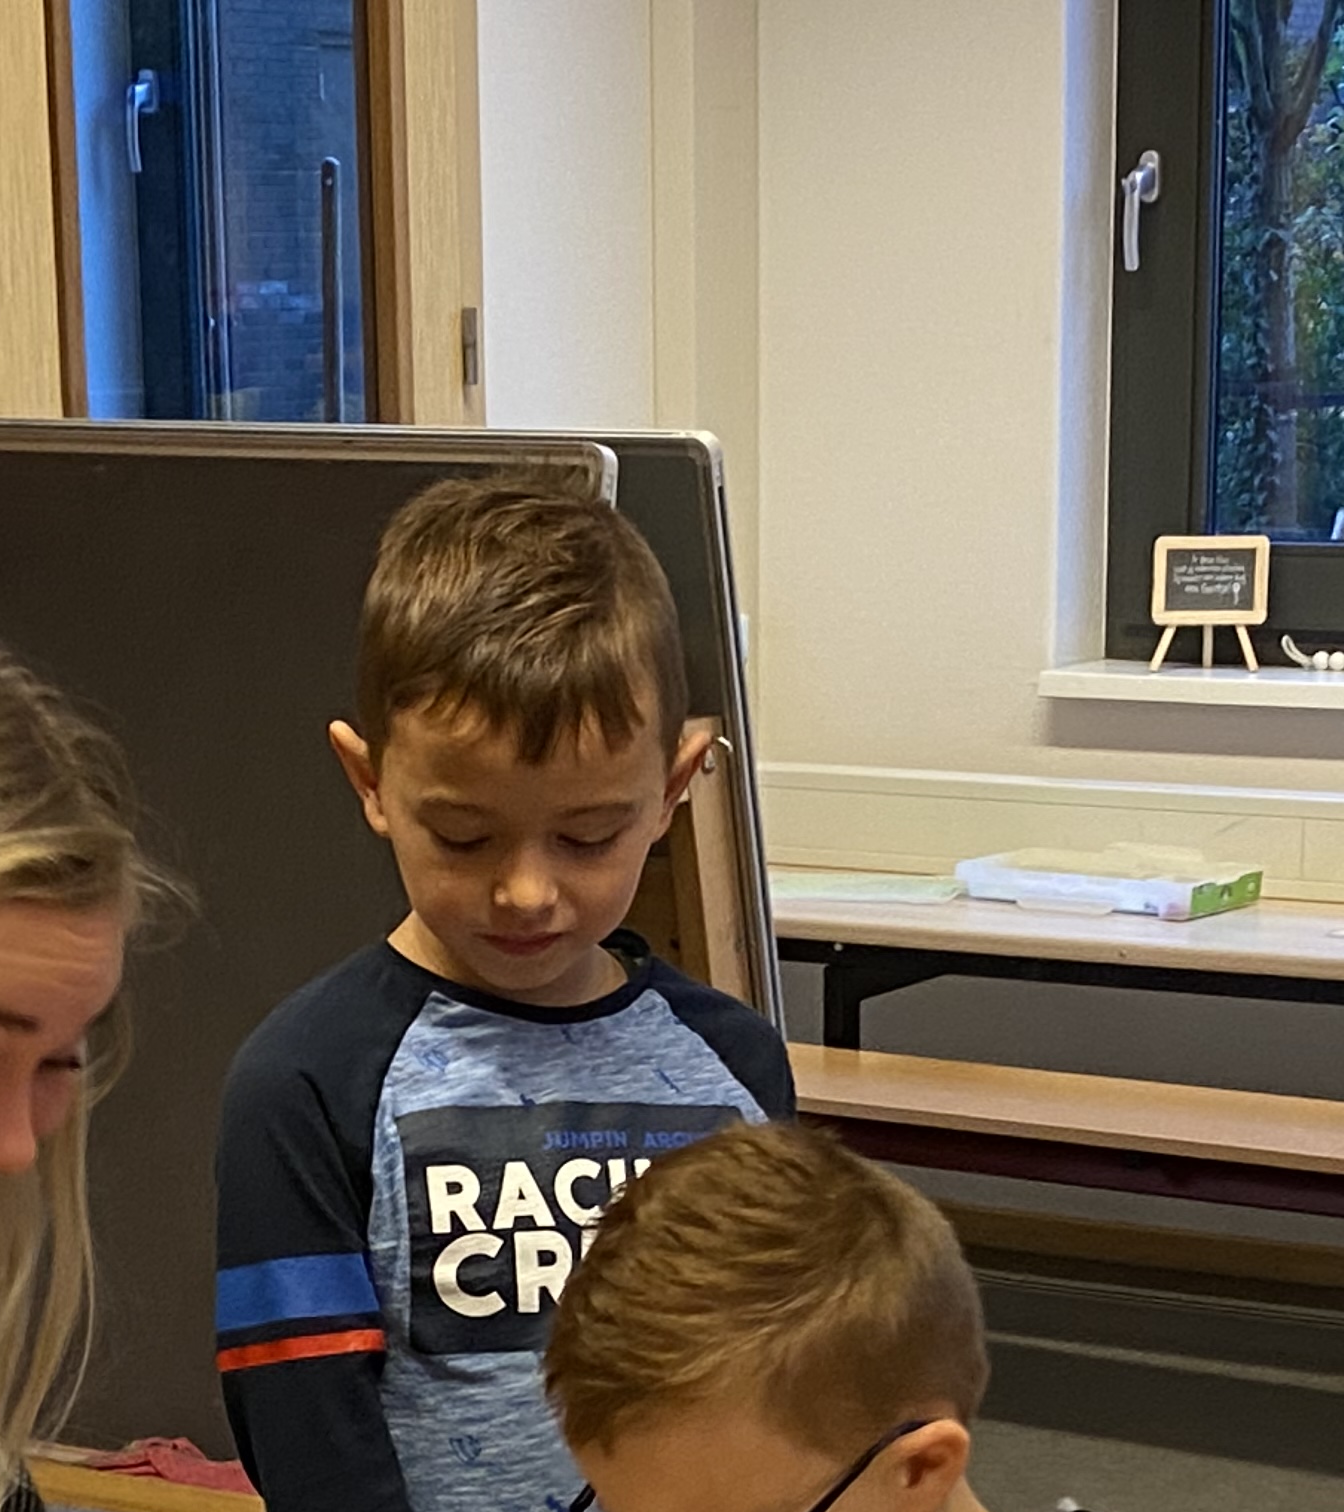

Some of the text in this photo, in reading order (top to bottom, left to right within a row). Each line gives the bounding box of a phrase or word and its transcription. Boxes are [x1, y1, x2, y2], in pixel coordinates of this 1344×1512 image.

[543, 1130, 628, 1149] JUMPIN
[425, 1157, 652, 1235] RACI
[432, 1229, 599, 1319] CR
